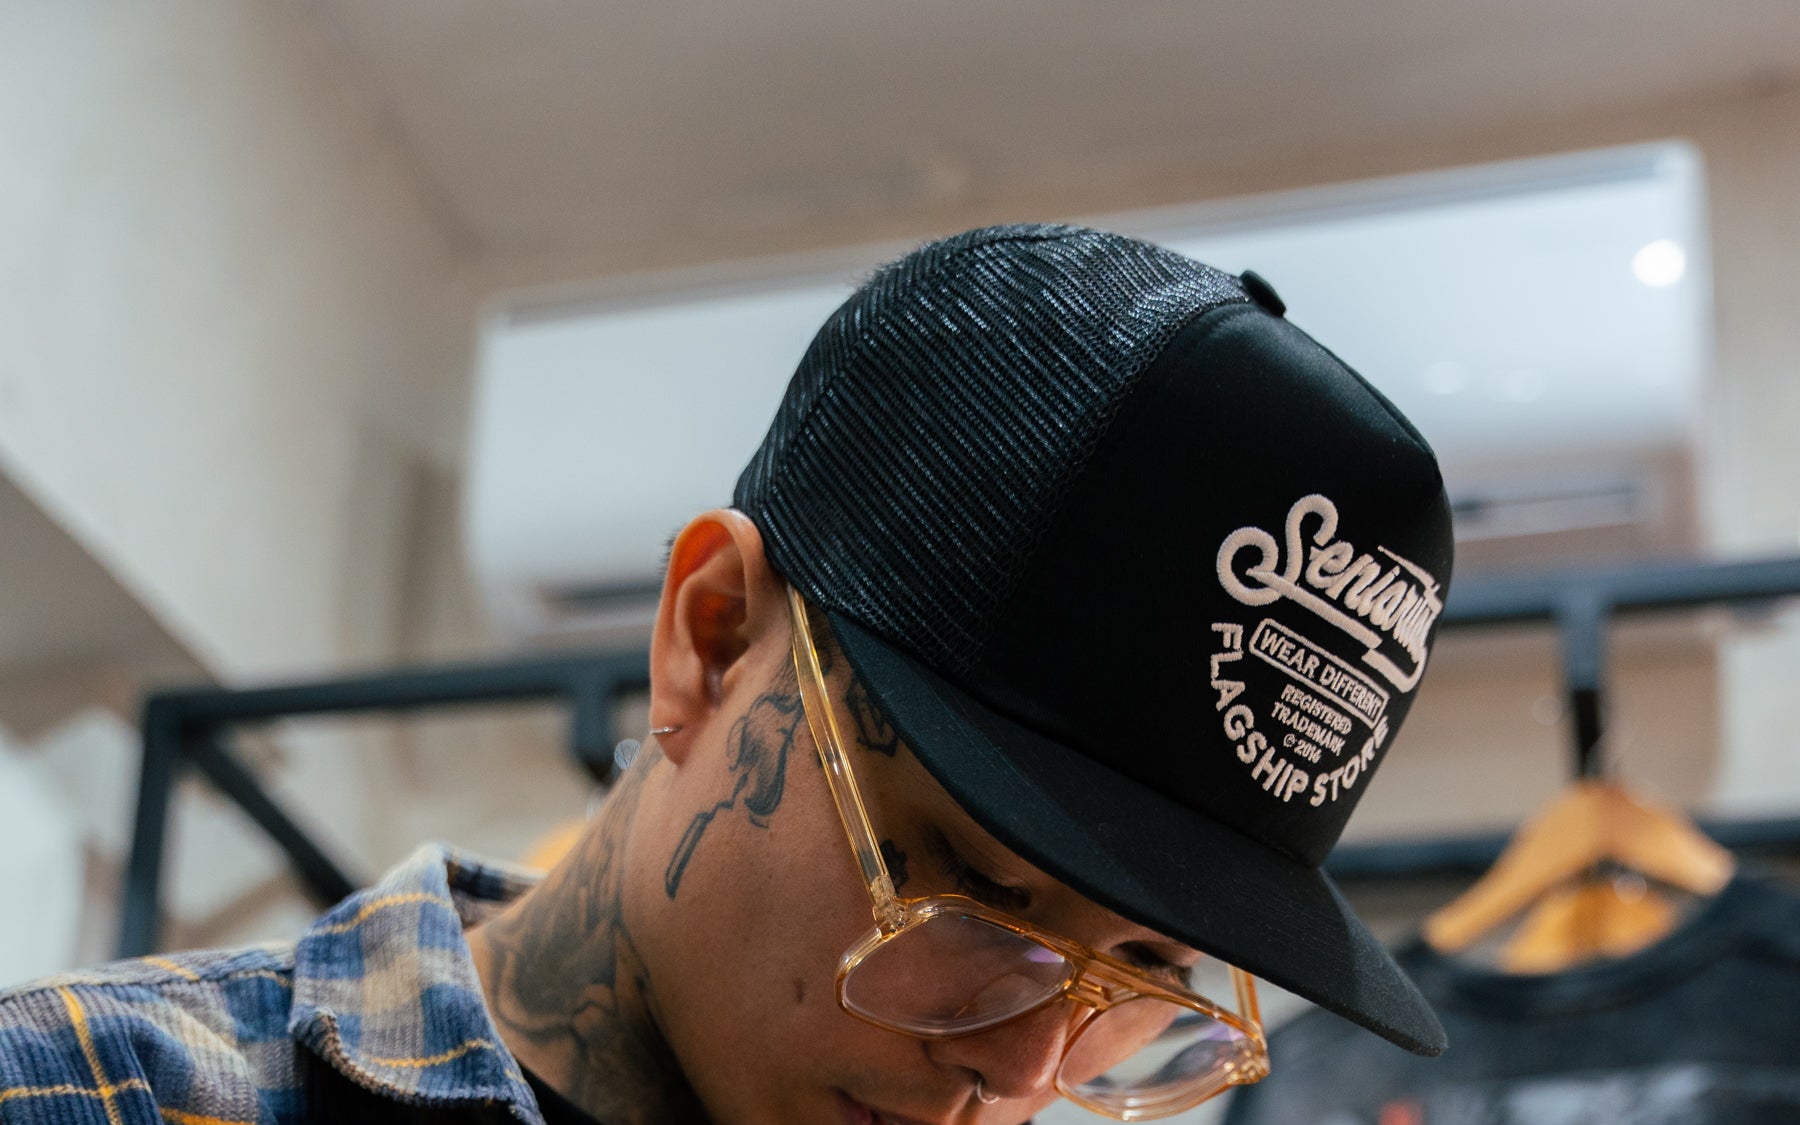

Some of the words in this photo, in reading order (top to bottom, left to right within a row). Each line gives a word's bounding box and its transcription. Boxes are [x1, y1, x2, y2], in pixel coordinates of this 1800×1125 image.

[1260, 628, 1321, 680] WEAR
[1319, 669, 1382, 718] DIFFERENT
[1281, 684, 1352, 735] REGISTERED
[1211, 621, 1309, 802] FLAGSHIP
[1310, 715, 1389, 807] STORE
[1271, 701, 1346, 757] TRADEMARK
